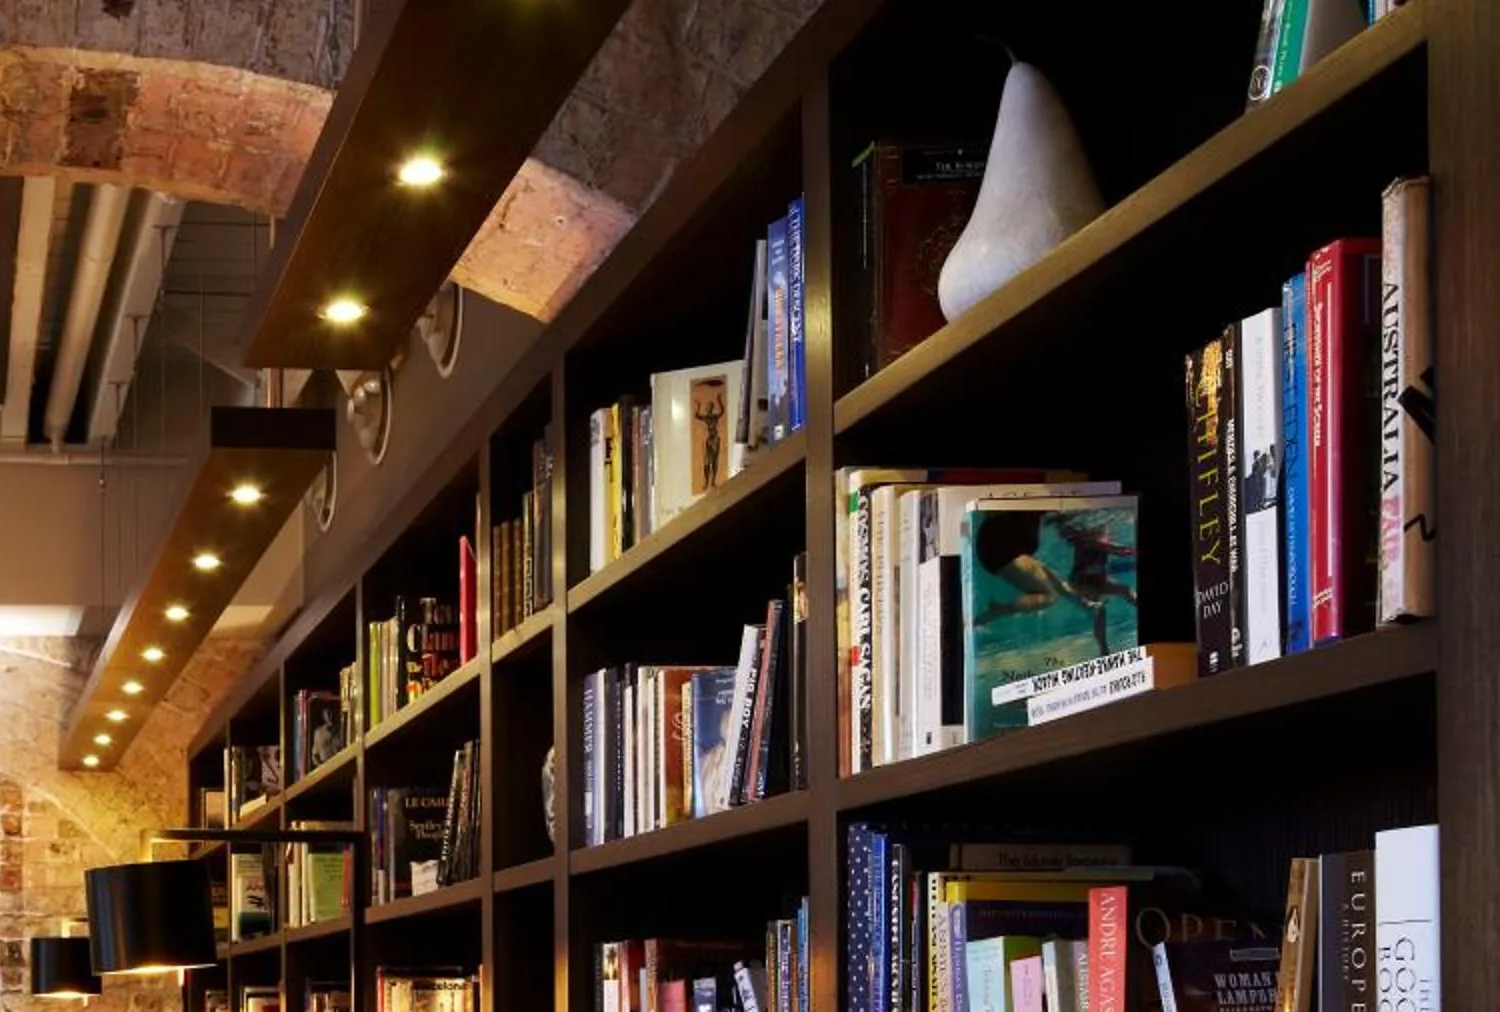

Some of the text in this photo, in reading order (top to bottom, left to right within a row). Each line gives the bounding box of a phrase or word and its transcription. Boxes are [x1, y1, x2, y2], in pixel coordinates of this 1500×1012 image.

[1381, 282, 1400, 492] AUSTRALIA
[1196, 386, 1220, 565] CHIFLEY
[859, 587, 872, 637] CARL
[860, 643, 872, 709] SAGAN
[1100, 894, 1116, 958] ANDRE
[1214, 971, 1271, 988] WOMAN
[1217, 988, 1278, 1005] LAMPSH
